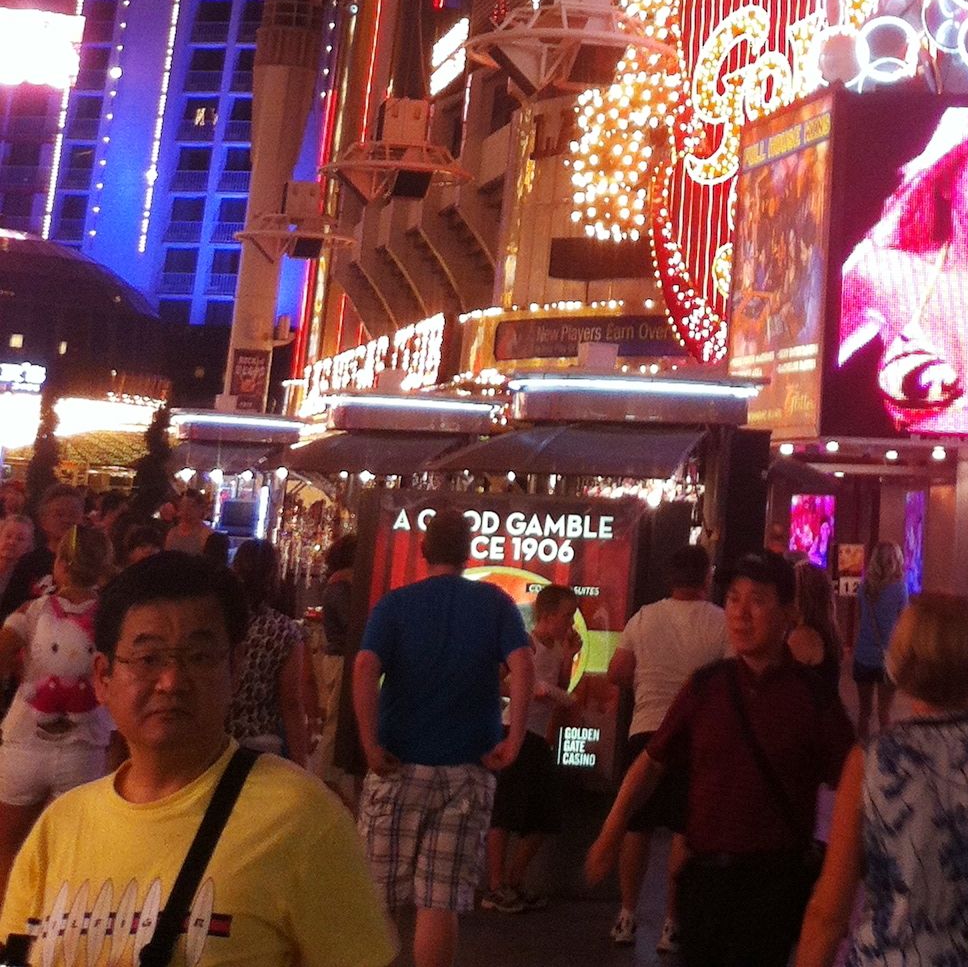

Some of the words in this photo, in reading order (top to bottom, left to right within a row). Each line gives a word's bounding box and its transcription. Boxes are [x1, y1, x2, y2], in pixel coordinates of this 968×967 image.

[561, 325, 602, 344] Players
[605, 322, 634, 341] Earn
[393, 508, 411, 531] A
[417, 508, 500, 536] GOD
[505, 511, 615, 539] GAMBLE
[511, 535, 575, 564] 1906
[564, 726, 600, 742] GOLDEN
[563, 739, 586, 753] GATE
[562, 752, 596, 767] CASINO
